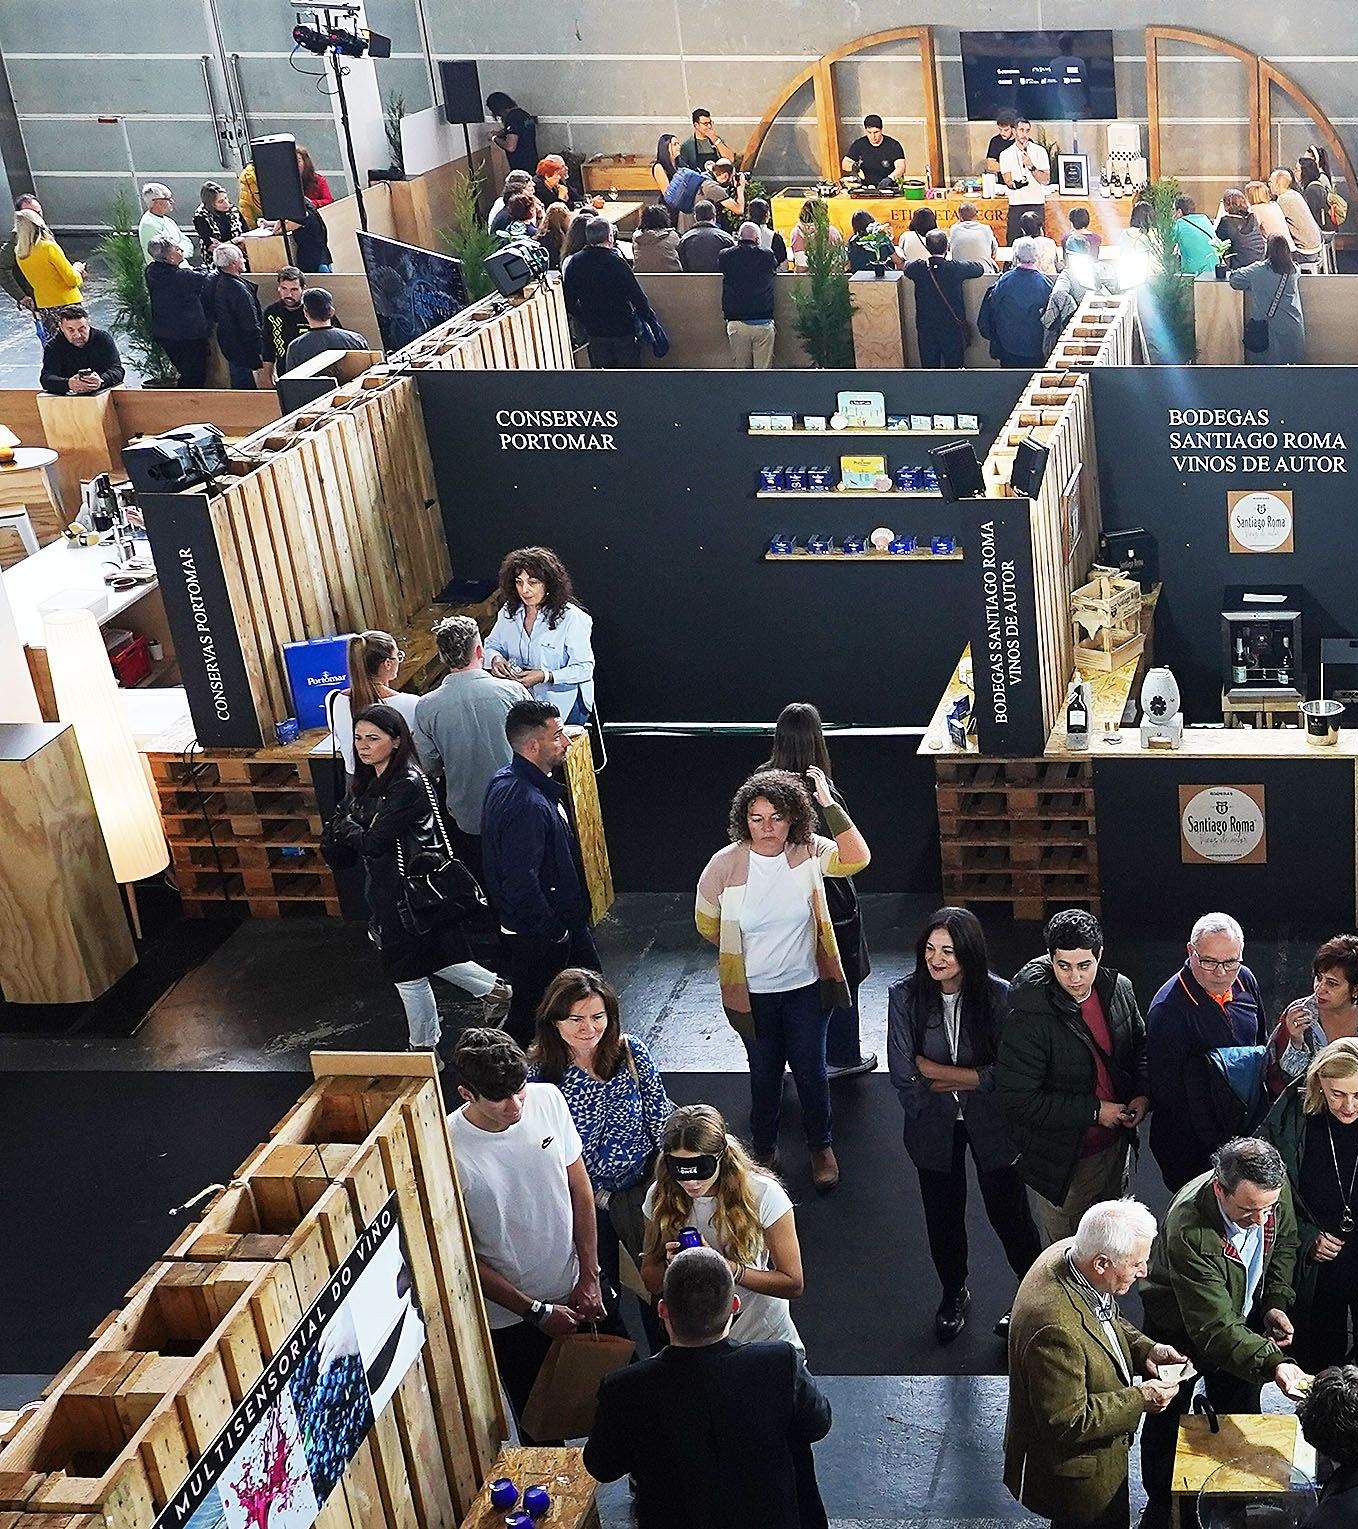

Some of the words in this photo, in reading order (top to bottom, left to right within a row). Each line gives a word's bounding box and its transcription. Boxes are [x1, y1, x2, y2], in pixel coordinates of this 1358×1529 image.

[891, 209, 960, 221] ETIETA
[495, 409, 619, 428] CONSERVAS
[1168, 409, 1269, 426] BODEGAS
[498, 433, 618, 450] PORTOMAR
[1169, 432, 1278, 449] SANTIAGO
[1282, 432, 1347, 449] ROMA
[1171, 455, 1237, 473] VINOS
[1241, 456, 1271, 472] DE
[1274, 455, 1347, 473] AUTOR
[1236, 515, 1266, 531] Santiago
[1267, 515, 1286, 528] Roma
[980, 520, 996, 568] ROMA
[178, 546, 212, 633] PORTOMAR
[1001, 559, 1018, 614] AUTOR
[983, 571, 1002, 650] SANTIAGO
[1005, 615, 1019, 637] DE
[1006, 638, 1022, 687] VINOS
[199, 635, 231, 722] CONSERVAS
[306, 673, 347, 686] Portomar
[989, 652, 1008, 724] BODEGAS
[1187, 815, 1227, 836] Santiago
[1229, 815, 1255, 834] Roma
[174, 1310, 327, 1521] MULTISENSORIAL
[331, 1266, 352, 1302] DO
